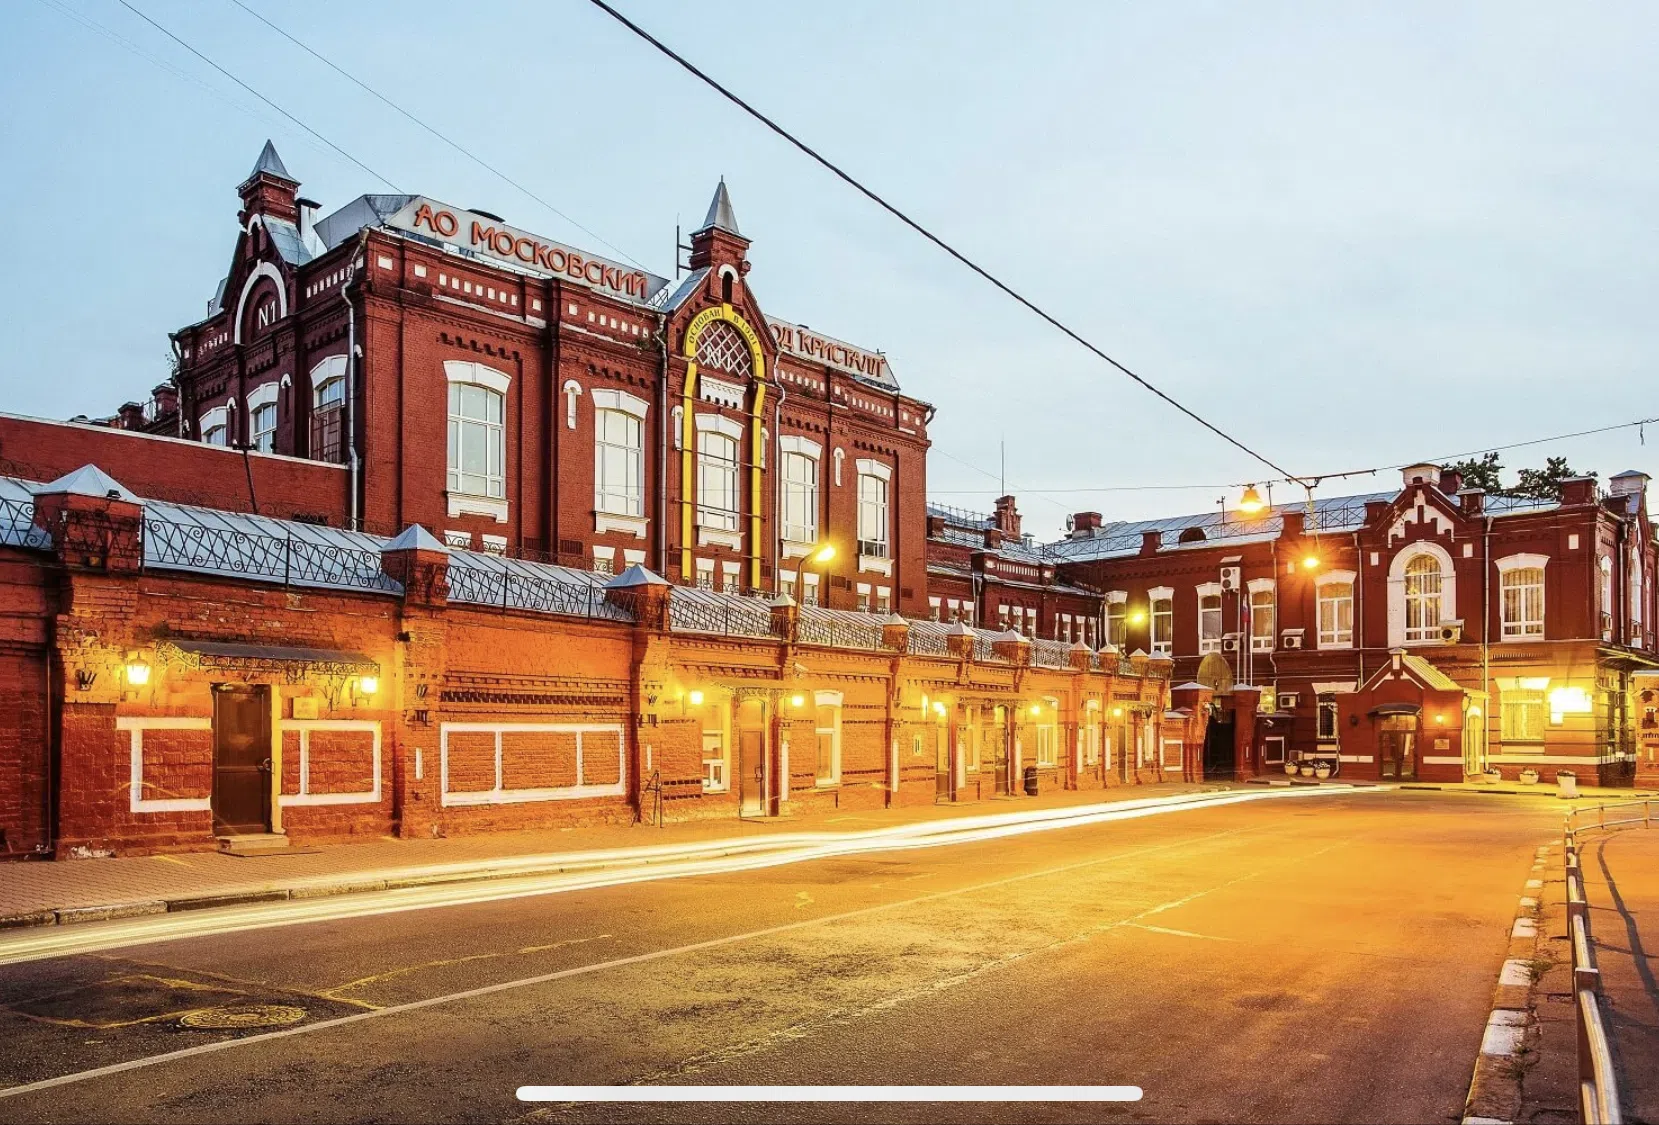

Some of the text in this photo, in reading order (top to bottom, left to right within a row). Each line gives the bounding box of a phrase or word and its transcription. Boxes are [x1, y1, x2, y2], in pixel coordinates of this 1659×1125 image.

[415, 204, 648, 299] АО МОСКОВСКИЙ
[688, 308, 720, 344] ОСНОВАН
[769, 323, 794, 352] ОД
